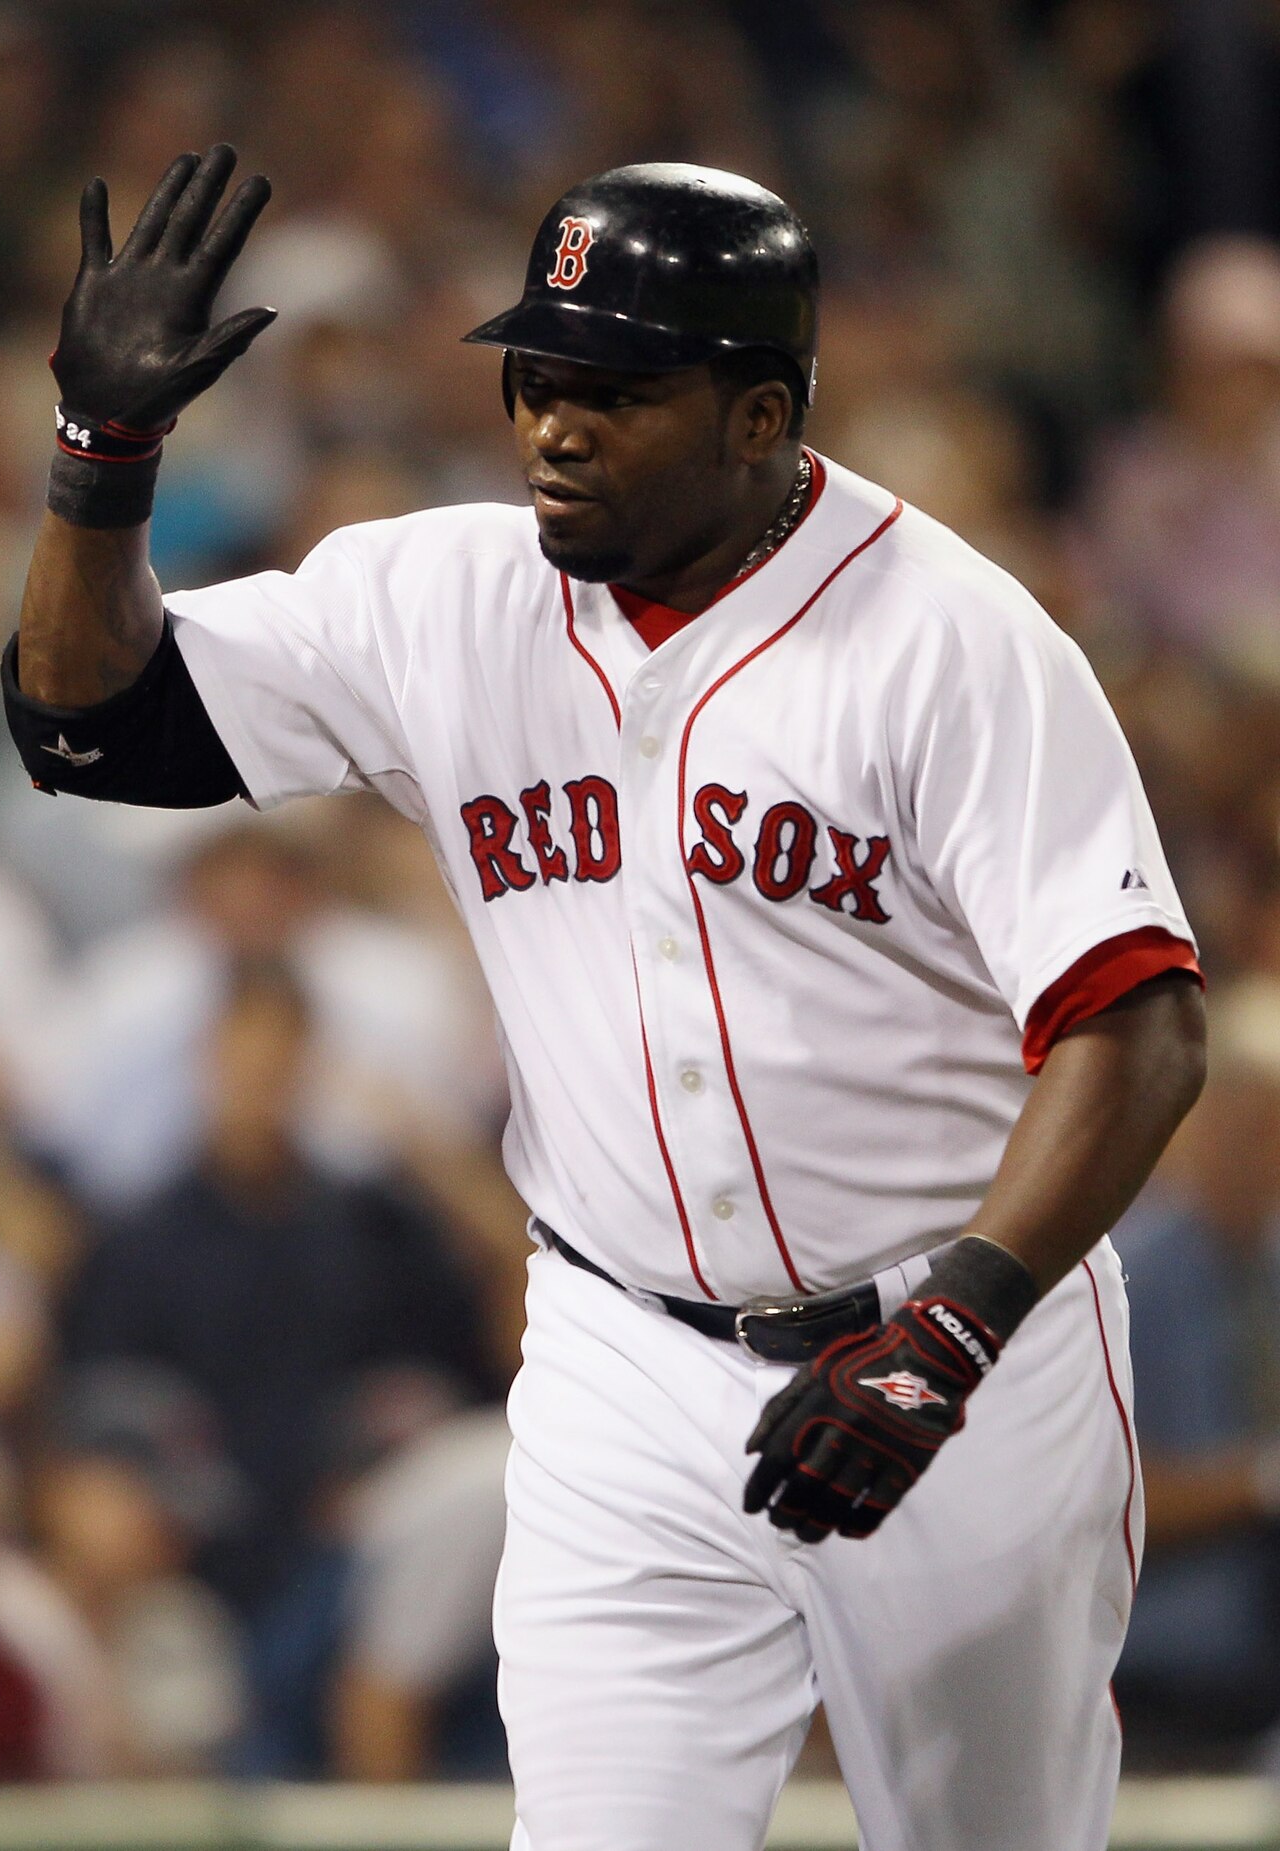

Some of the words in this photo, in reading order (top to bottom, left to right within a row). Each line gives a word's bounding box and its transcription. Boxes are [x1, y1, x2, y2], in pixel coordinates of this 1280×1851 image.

[547, 216, 597, 290] B
[460, 775, 622, 902] RED
[688, 783, 892, 924] SOX
